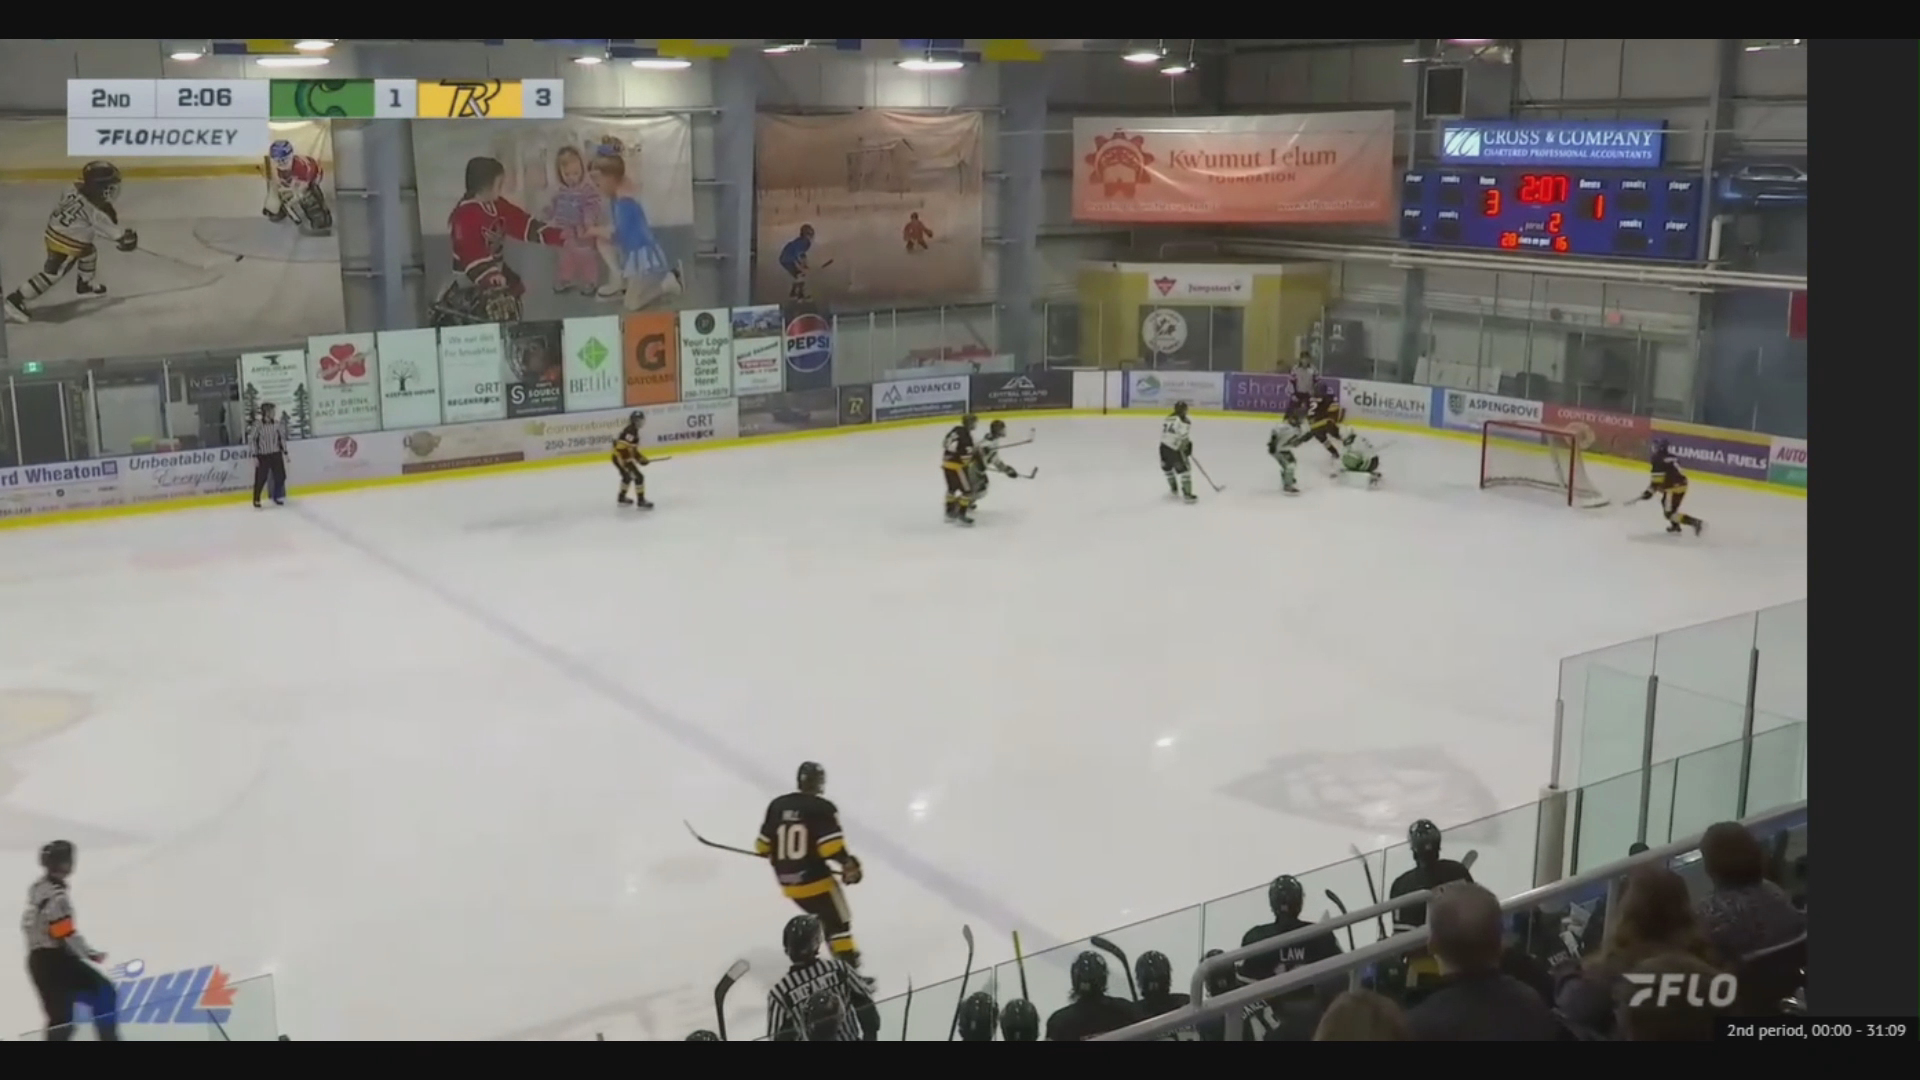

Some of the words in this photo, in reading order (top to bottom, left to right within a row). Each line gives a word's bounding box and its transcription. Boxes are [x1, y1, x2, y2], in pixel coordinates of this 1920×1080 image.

[1484, 130, 1540, 146] CROSS
[1546, 130, 1554, 143] &
[1559, 130, 1654, 147] COMPANY
[1484, 148, 1528, 157] CHARTERED
[1530, 149, 1587, 158] PROFESSIONAL
[1590, 150, 1652, 159] ACCOUNTANTS
[1208, 172, 1296, 184] FOUNDATION
[1521, 174, 1566, 202] 2:07
[1486, 189, 1500, 215] 3
[1597, 194, 1604, 219] 1
[1549, 212, 1561, 233] 2
[636, 333, 666, 371] G
[787, 335, 830, 351] PEPSI
[475, 382, 501, 395] GRT
[906, 381, 962, 395] ADVANCED
[1353, 392, 1377, 408] cbi
[1378, 397, 1426, 413] HEALTH
[1469, 399, 1540, 418] ASPENGROVE
[686, 413, 715, 428] GRT
[129, 450, 216, 471] Unbeatable
[220, 448, 254, 461] Deal
[1652, 445, 1725, 463] LUMBIA
[1727, 454, 1768, 470] FUELS
[25, 465, 100, 483] Wheaton
[777, 823, 809, 860] 10
[1279, 947, 1305, 962] LAW
